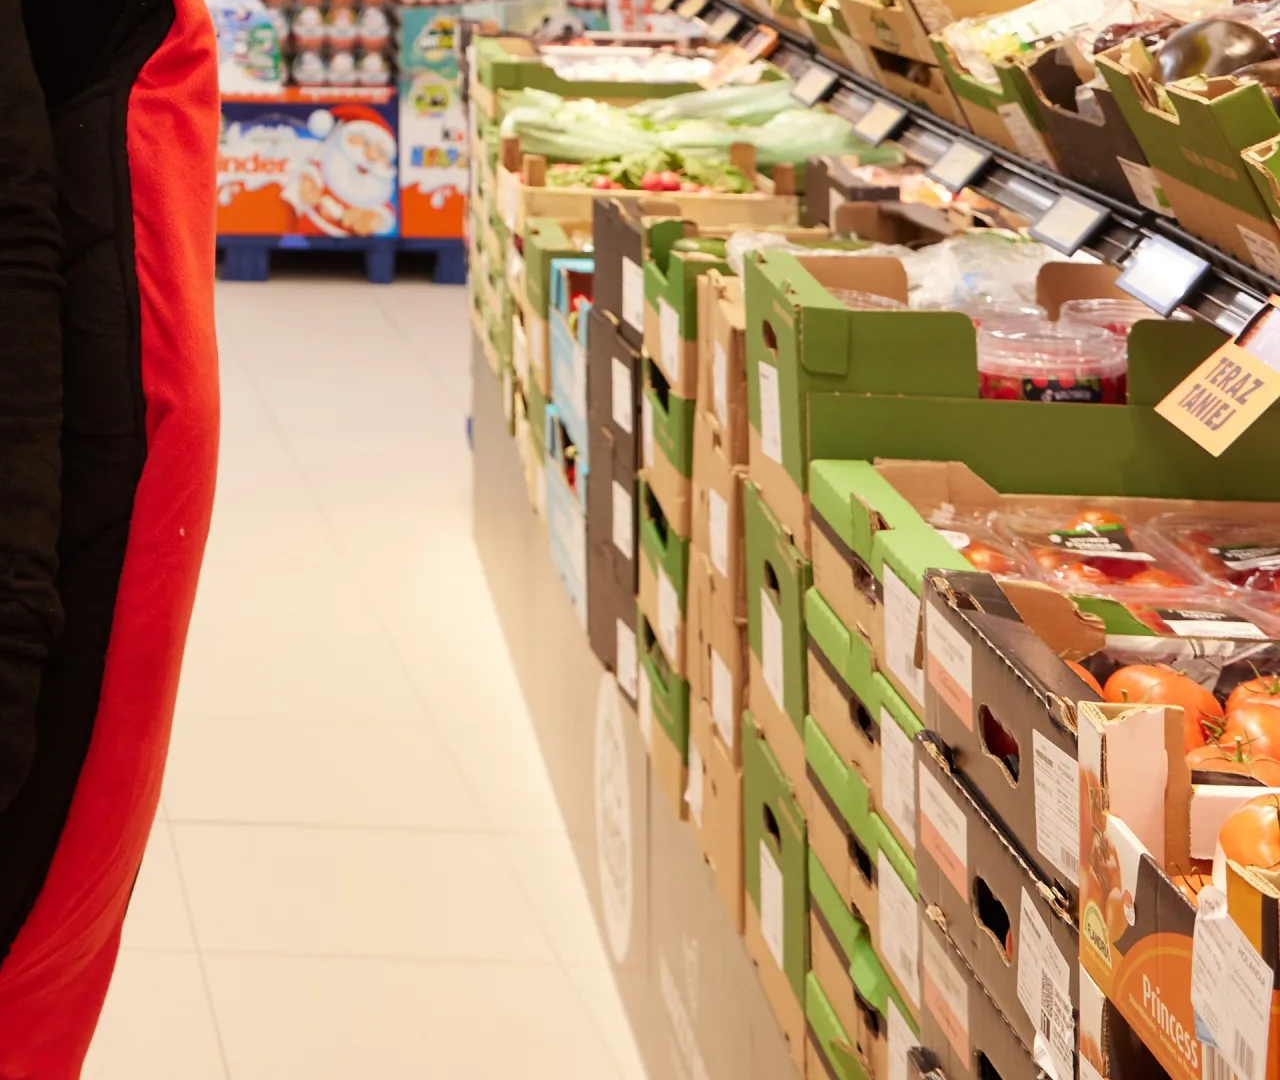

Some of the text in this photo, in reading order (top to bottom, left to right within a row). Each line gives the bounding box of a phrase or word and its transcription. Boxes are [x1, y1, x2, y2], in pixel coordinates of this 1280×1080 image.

[1203, 356, 1265, 406] TERAZ
[1178, 382, 1237, 431] TANIEJ
[1086, 922, 1110, 959] FLANDRIA
[1142, 973, 1200, 1069] Princess
